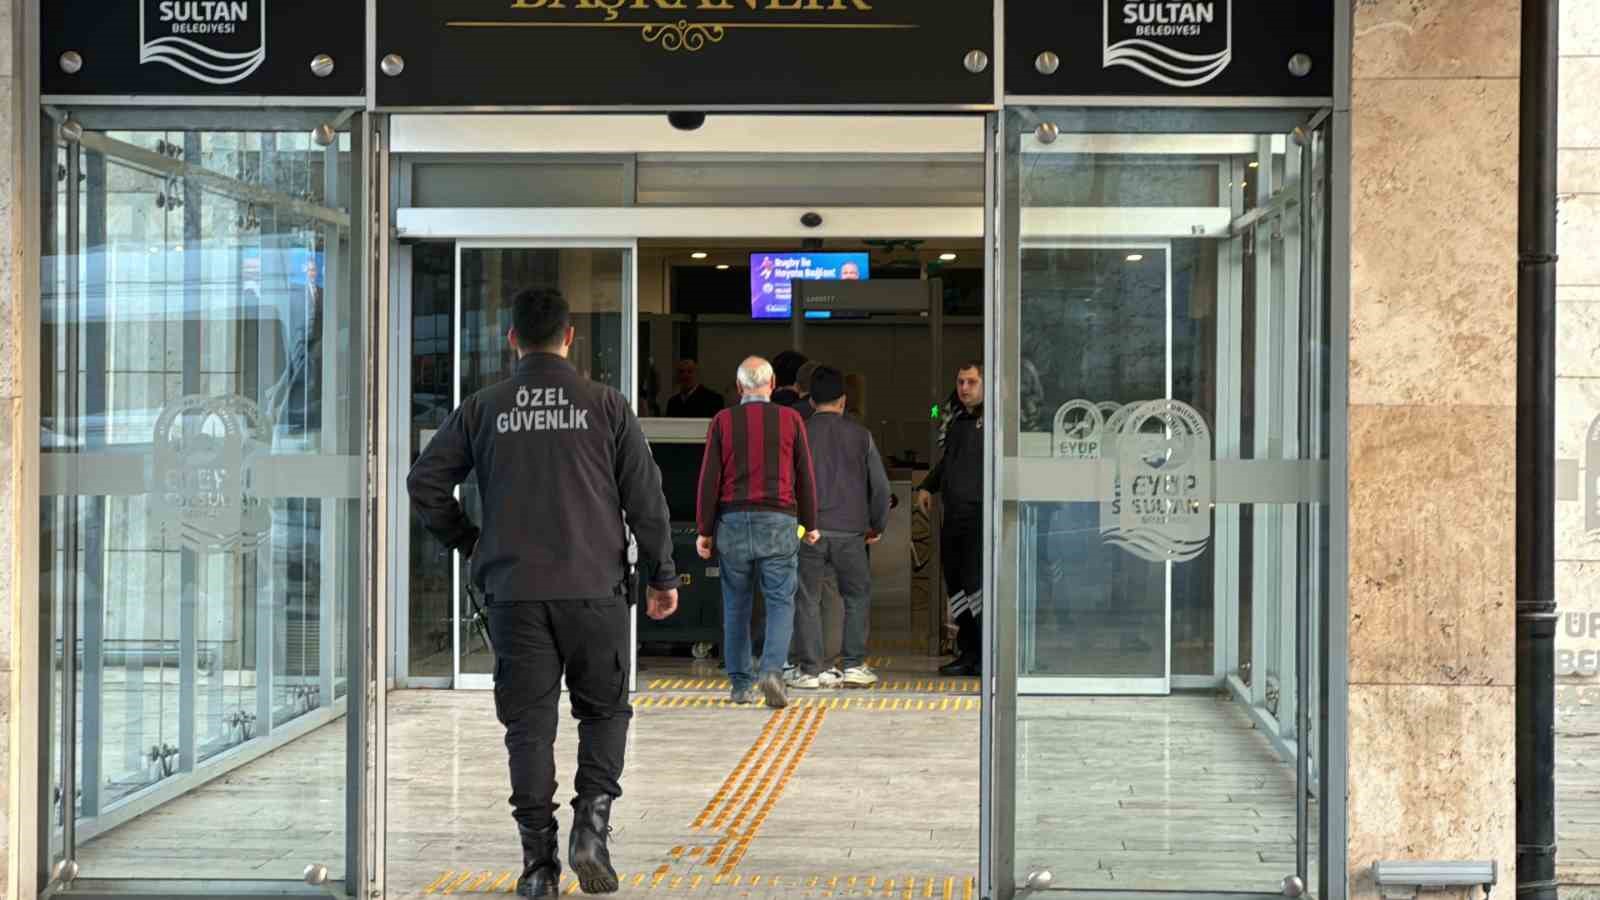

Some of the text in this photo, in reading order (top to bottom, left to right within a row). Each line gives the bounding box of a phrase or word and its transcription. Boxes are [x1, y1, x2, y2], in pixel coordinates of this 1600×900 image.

[160, 1, 247, 21] SULTAN
[1123, 2, 1214, 23] SULTAN
[516, 386, 569, 407] ÖZEL
[497, 404, 588, 433] GÜVENLİK
[1556, 649, 1600, 674] BE
